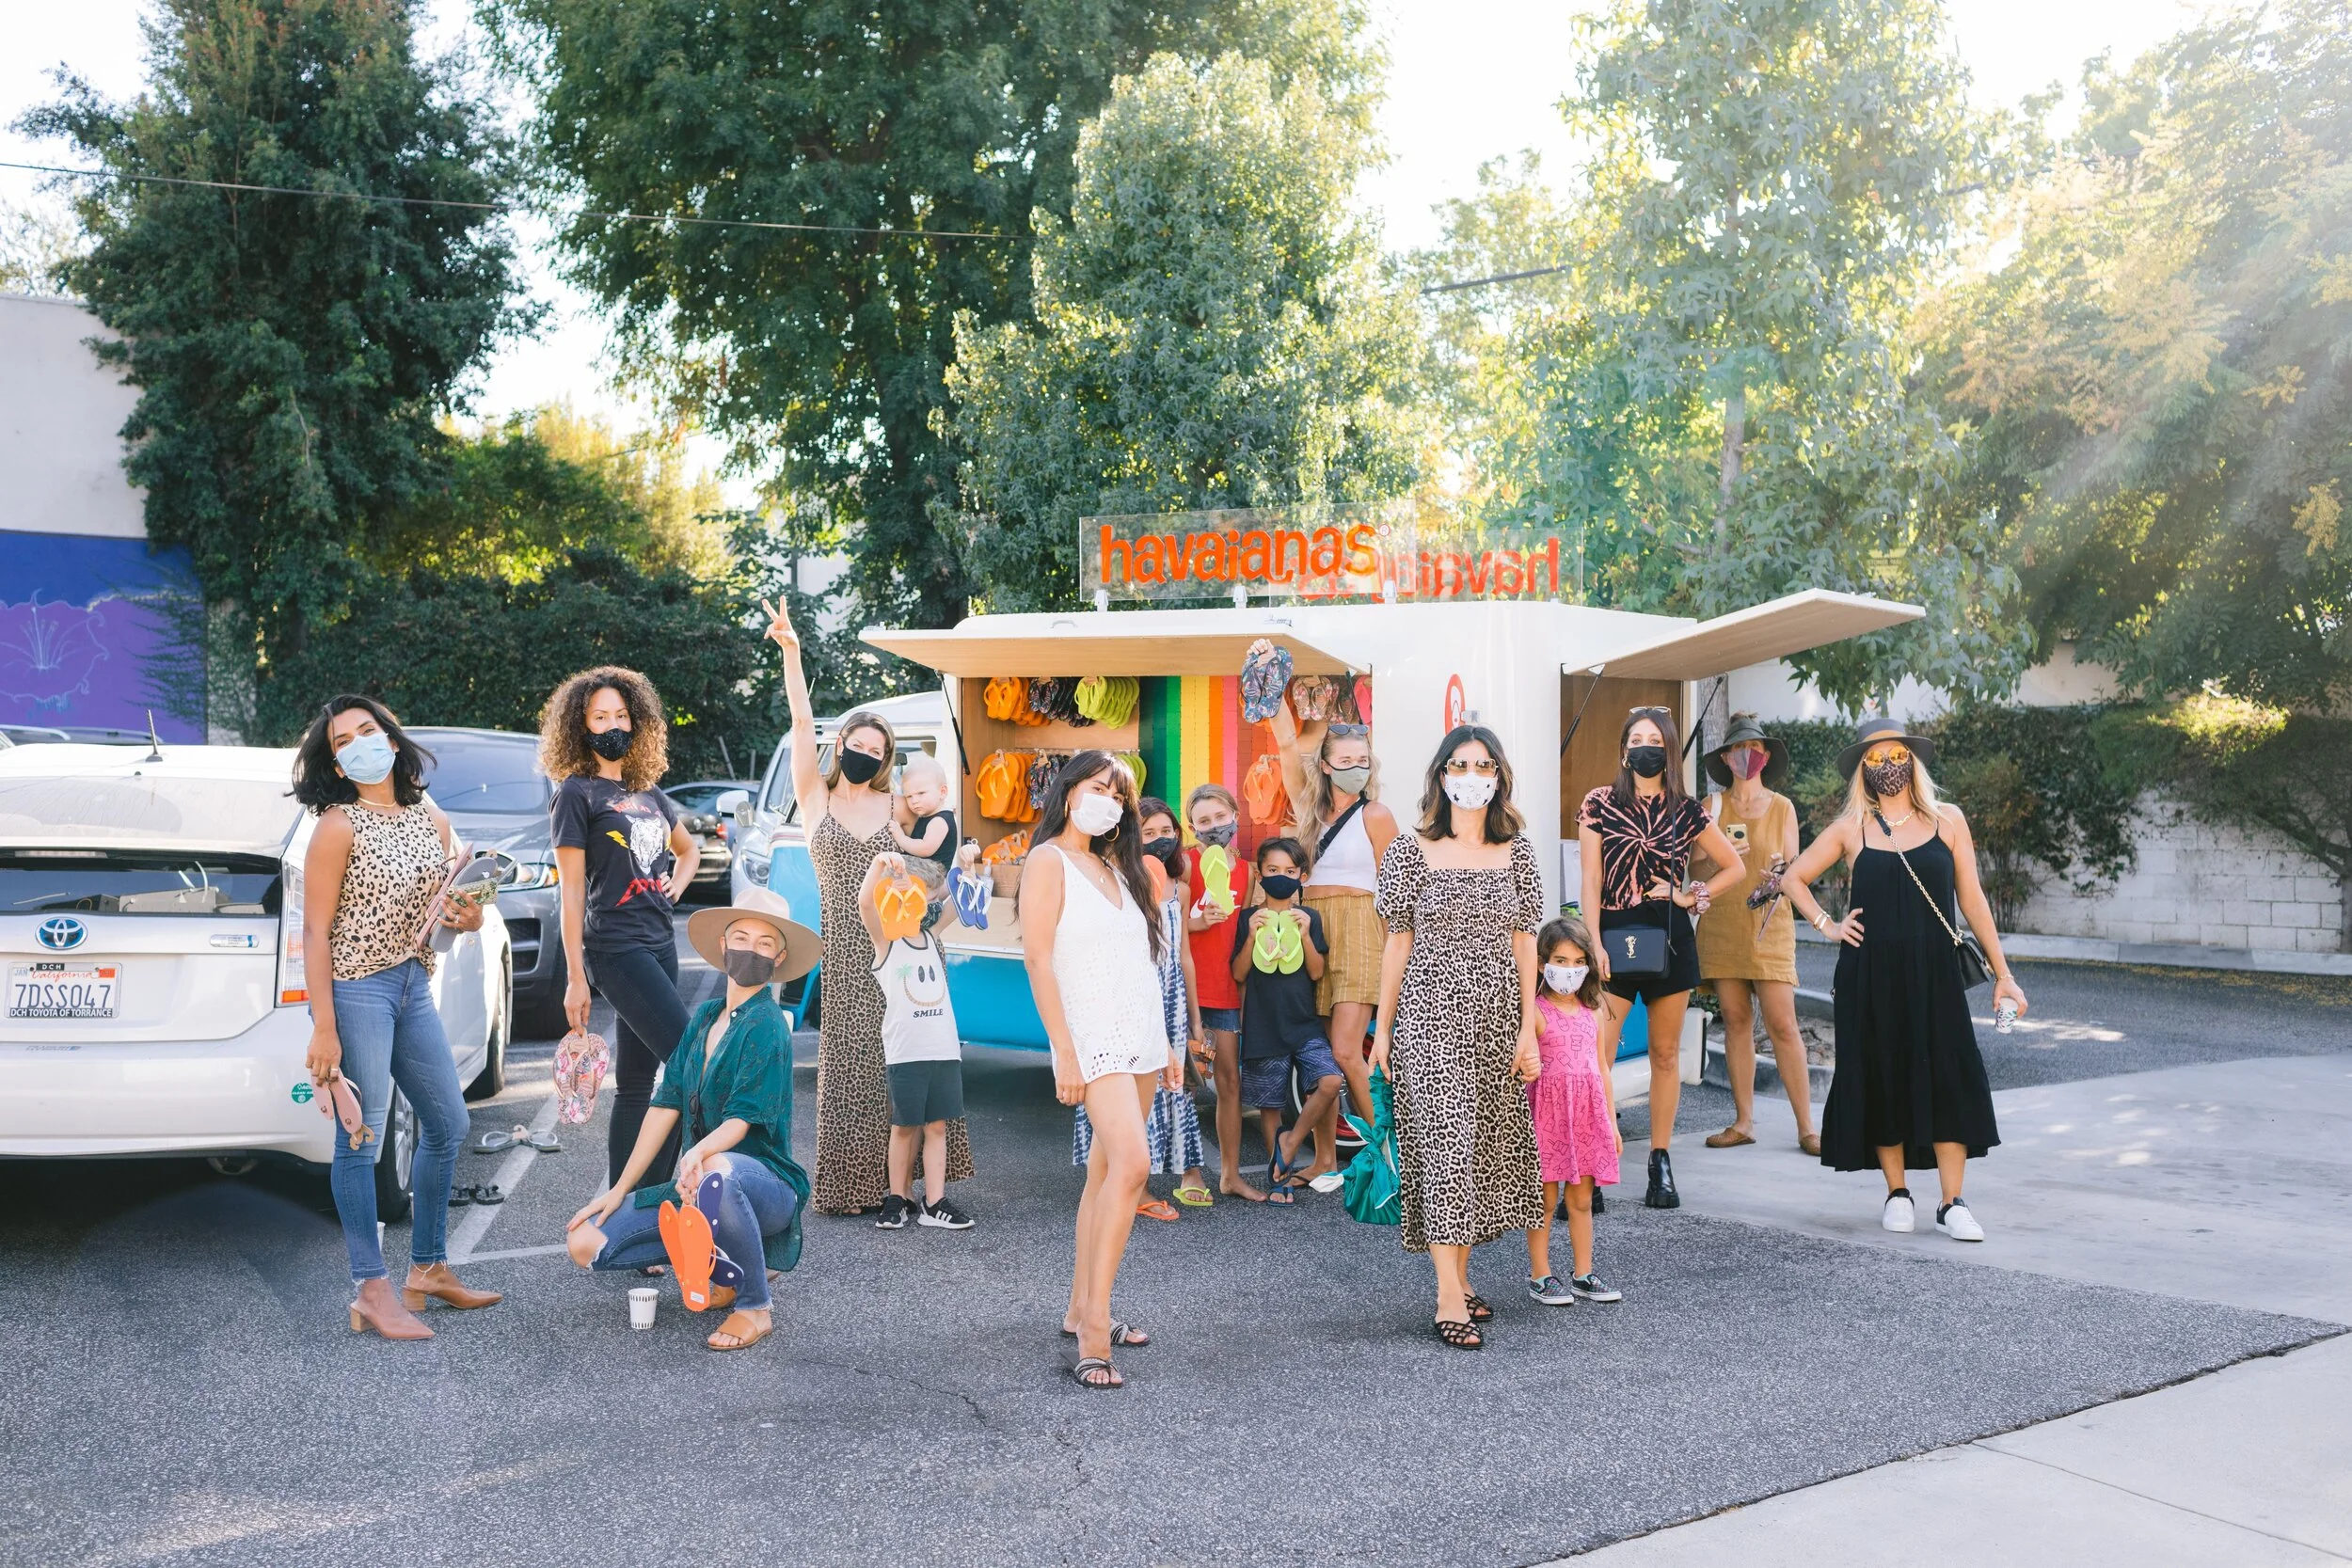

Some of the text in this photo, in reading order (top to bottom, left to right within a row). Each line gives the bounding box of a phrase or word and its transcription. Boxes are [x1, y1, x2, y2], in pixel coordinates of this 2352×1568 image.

[1099, 524, 1377, 584] havaianas
[15, 984, 111, 1009] 7DSS047
[10, 1008, 112, 1017] DCH TOYOTA OF TORRANCE
[914, 1008, 944, 1018] SMILE
